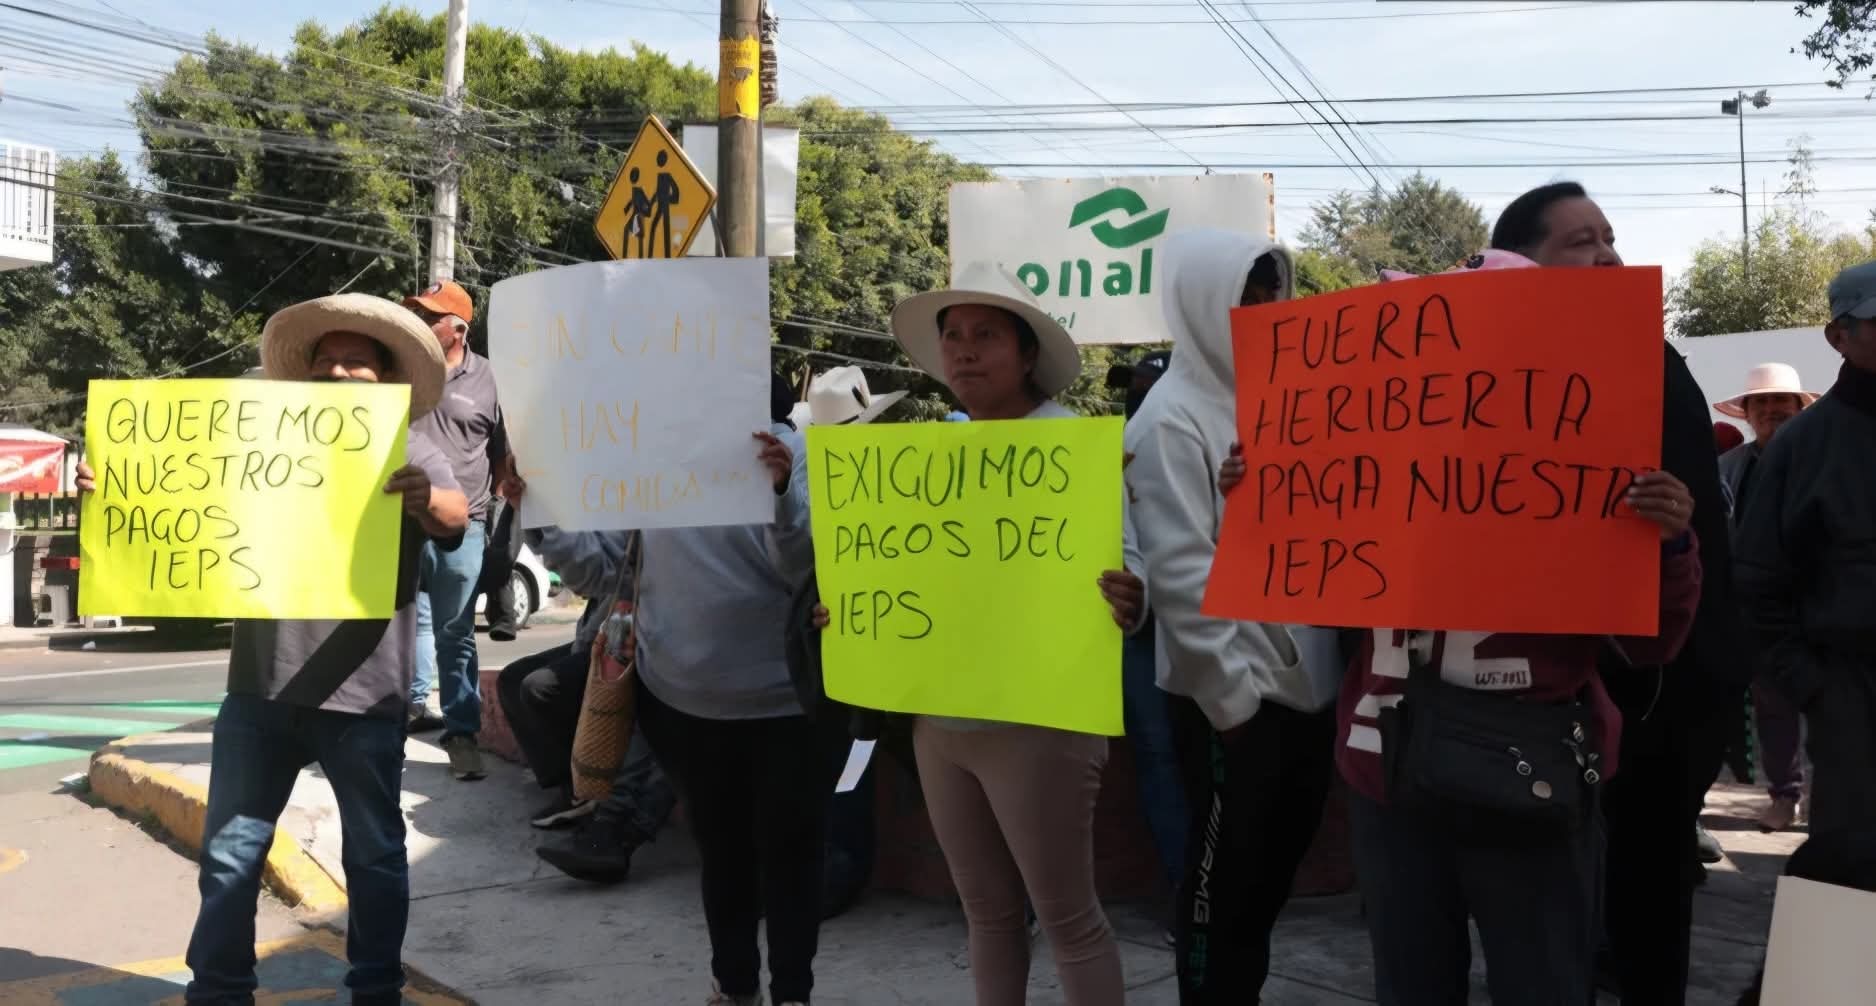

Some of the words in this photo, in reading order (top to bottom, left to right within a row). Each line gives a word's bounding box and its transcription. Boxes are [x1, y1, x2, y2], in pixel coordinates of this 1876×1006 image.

[1269, 294, 1460, 384] FUERA
[106, 397, 371, 452] QUEREMOS
[1254, 368, 1592, 448] HERIBERTA
[103, 450, 324, 500] NUESTROS
[825, 444, 1071, 511] EXIGUIMOS
[1258, 455, 1381, 524] PAGA
[1408, 453, 1657, 522] NUESTR
[104, 505, 240, 547] PAGOS
[835, 520, 971, 563] PAGOS
[150, 546, 261, 591] IEPS
[1264, 539, 1387, 600] IEPS
[840, 590, 933, 641] IEPS
